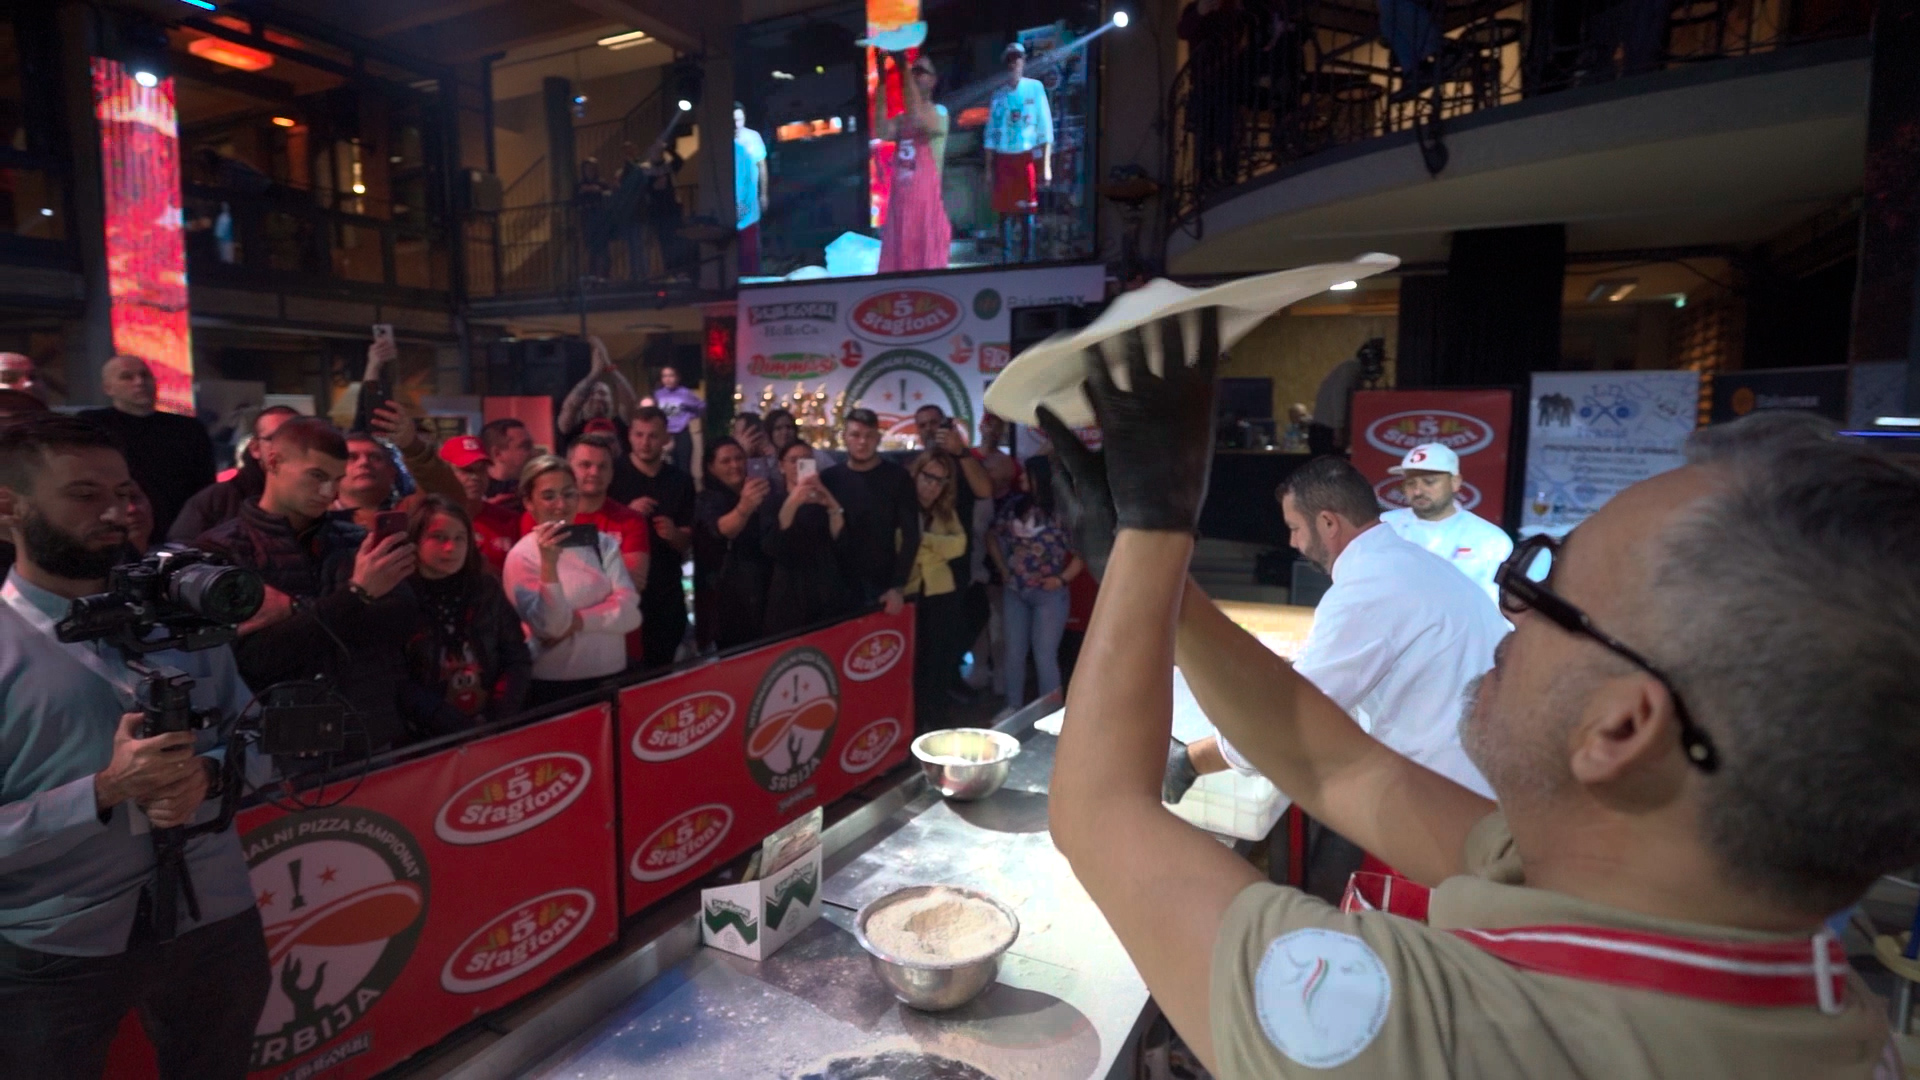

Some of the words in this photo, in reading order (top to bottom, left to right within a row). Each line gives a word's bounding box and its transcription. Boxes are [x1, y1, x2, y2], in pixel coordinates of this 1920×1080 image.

[862, 307, 950, 335] Stagioni
[893, 300, 913, 317] 5
[1417, 419, 1439, 436] 5
[648, 708, 725, 747] Stagioni
[678, 707, 696, 727] 5
[506, 772, 533, 800] 5
[768, 757, 821, 791] SRBIJA
[459, 772, 577, 825] Stagioni
[299, 818, 350, 835] PIZZA
[352, 817, 420, 878] ŠAMPIONAT
[646, 819, 723, 865] Stagioni
[676, 821, 694, 844] 5
[465, 907, 580, 973] Stagioni
[511, 912, 537, 942] 5
